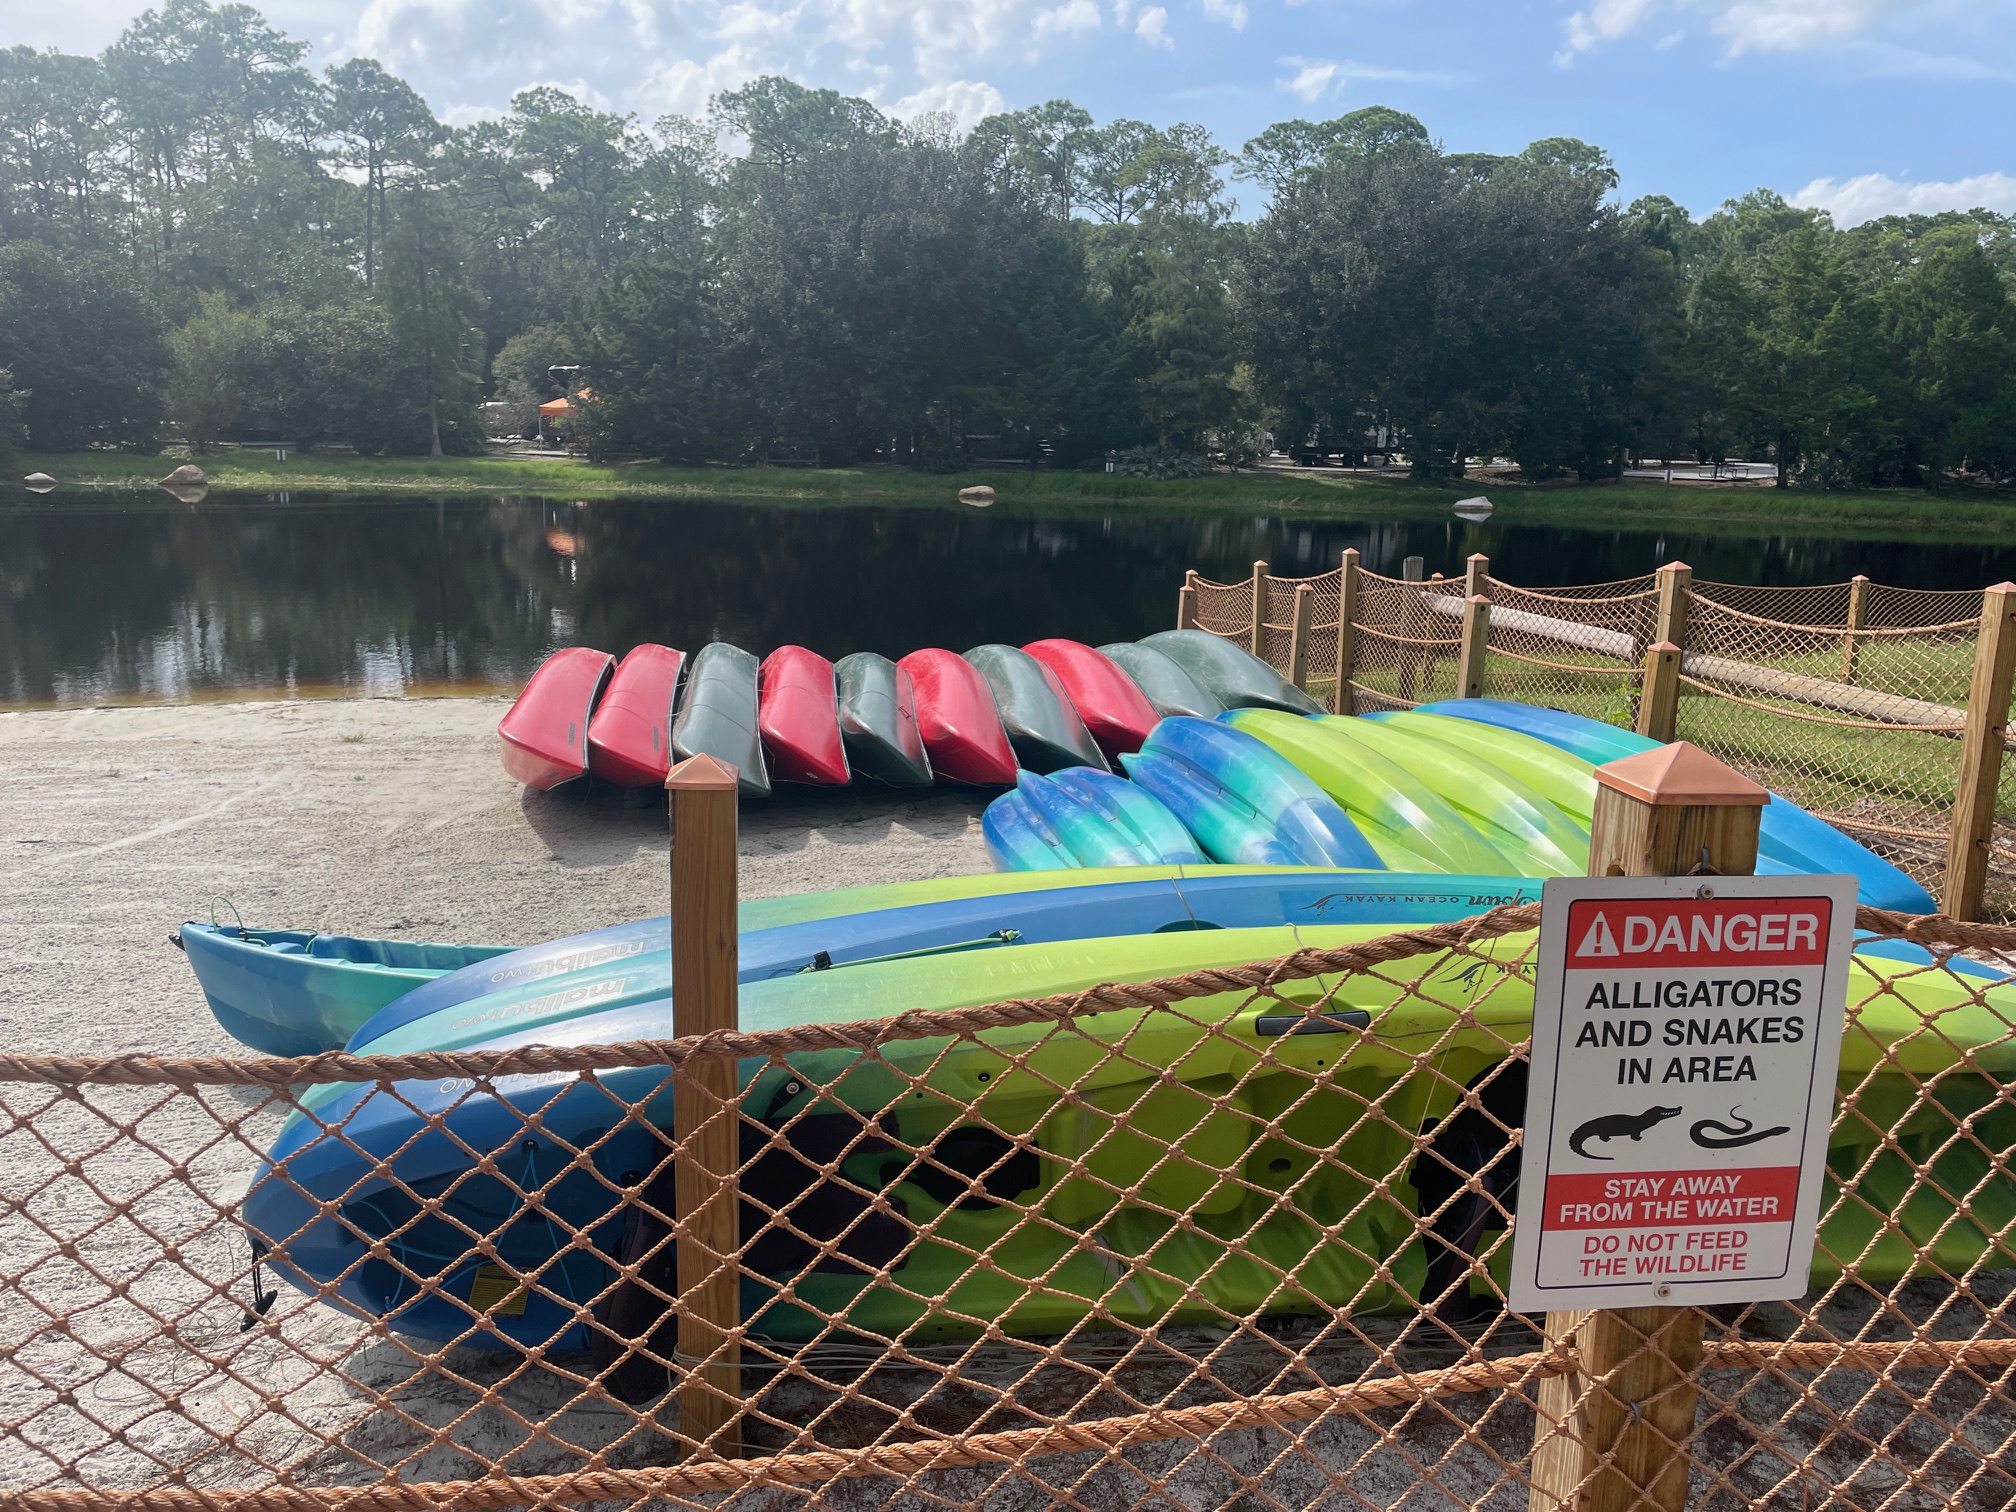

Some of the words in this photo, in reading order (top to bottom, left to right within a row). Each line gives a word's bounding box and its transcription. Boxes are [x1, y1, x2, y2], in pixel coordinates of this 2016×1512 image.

[1345, 895, 1399, 903] KAYAK
[1404, 895, 1460, 904] OCEAN
[1622, 913, 1819, 954] DANGER
[1585, 978, 1802, 1010] ALLIGATORS
[1575, 1020, 1652, 1049] AND
[1662, 1016, 1804, 1046] SNAKES
[1617, 1057, 1651, 1085] IN
[1661, 1055, 1757, 1083] AREA
[1604, 1177, 1667, 1199] STAY
[1671, 1175, 1742, 1196] AWAY
[1559, 1201, 1637, 1223] FROM
[1641, 1199, 1691, 1221] THE
[1695, 1196, 1779, 1218] WATER
[1583, 1235, 1620, 1255] DO
[1627, 1232, 1681, 1253] NOT
[1684, 1230, 1748, 1251] FEED
[1579, 1257, 1631, 1277] THE
[1635, 1252, 1747, 1274] WILDLIFE
